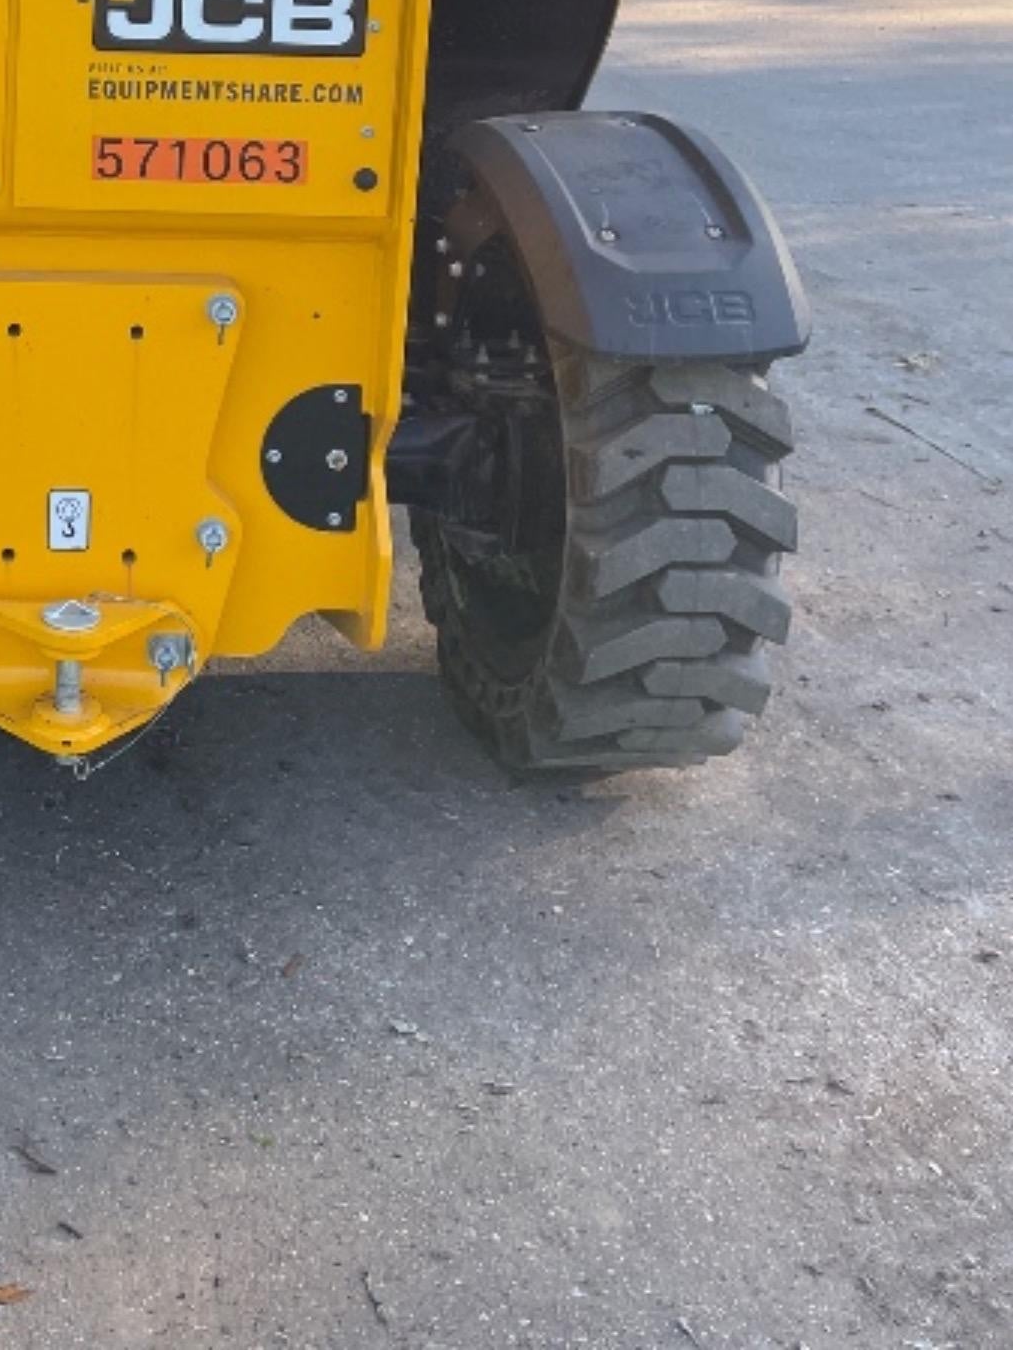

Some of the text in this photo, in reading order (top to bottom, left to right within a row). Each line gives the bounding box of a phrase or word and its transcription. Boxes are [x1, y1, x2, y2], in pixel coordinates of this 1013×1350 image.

[88, 79, 364, 106] EQUIPMENTSHARE.COM
[96, 137, 302, 184] 571063
[625, 290, 756, 327] JCB
